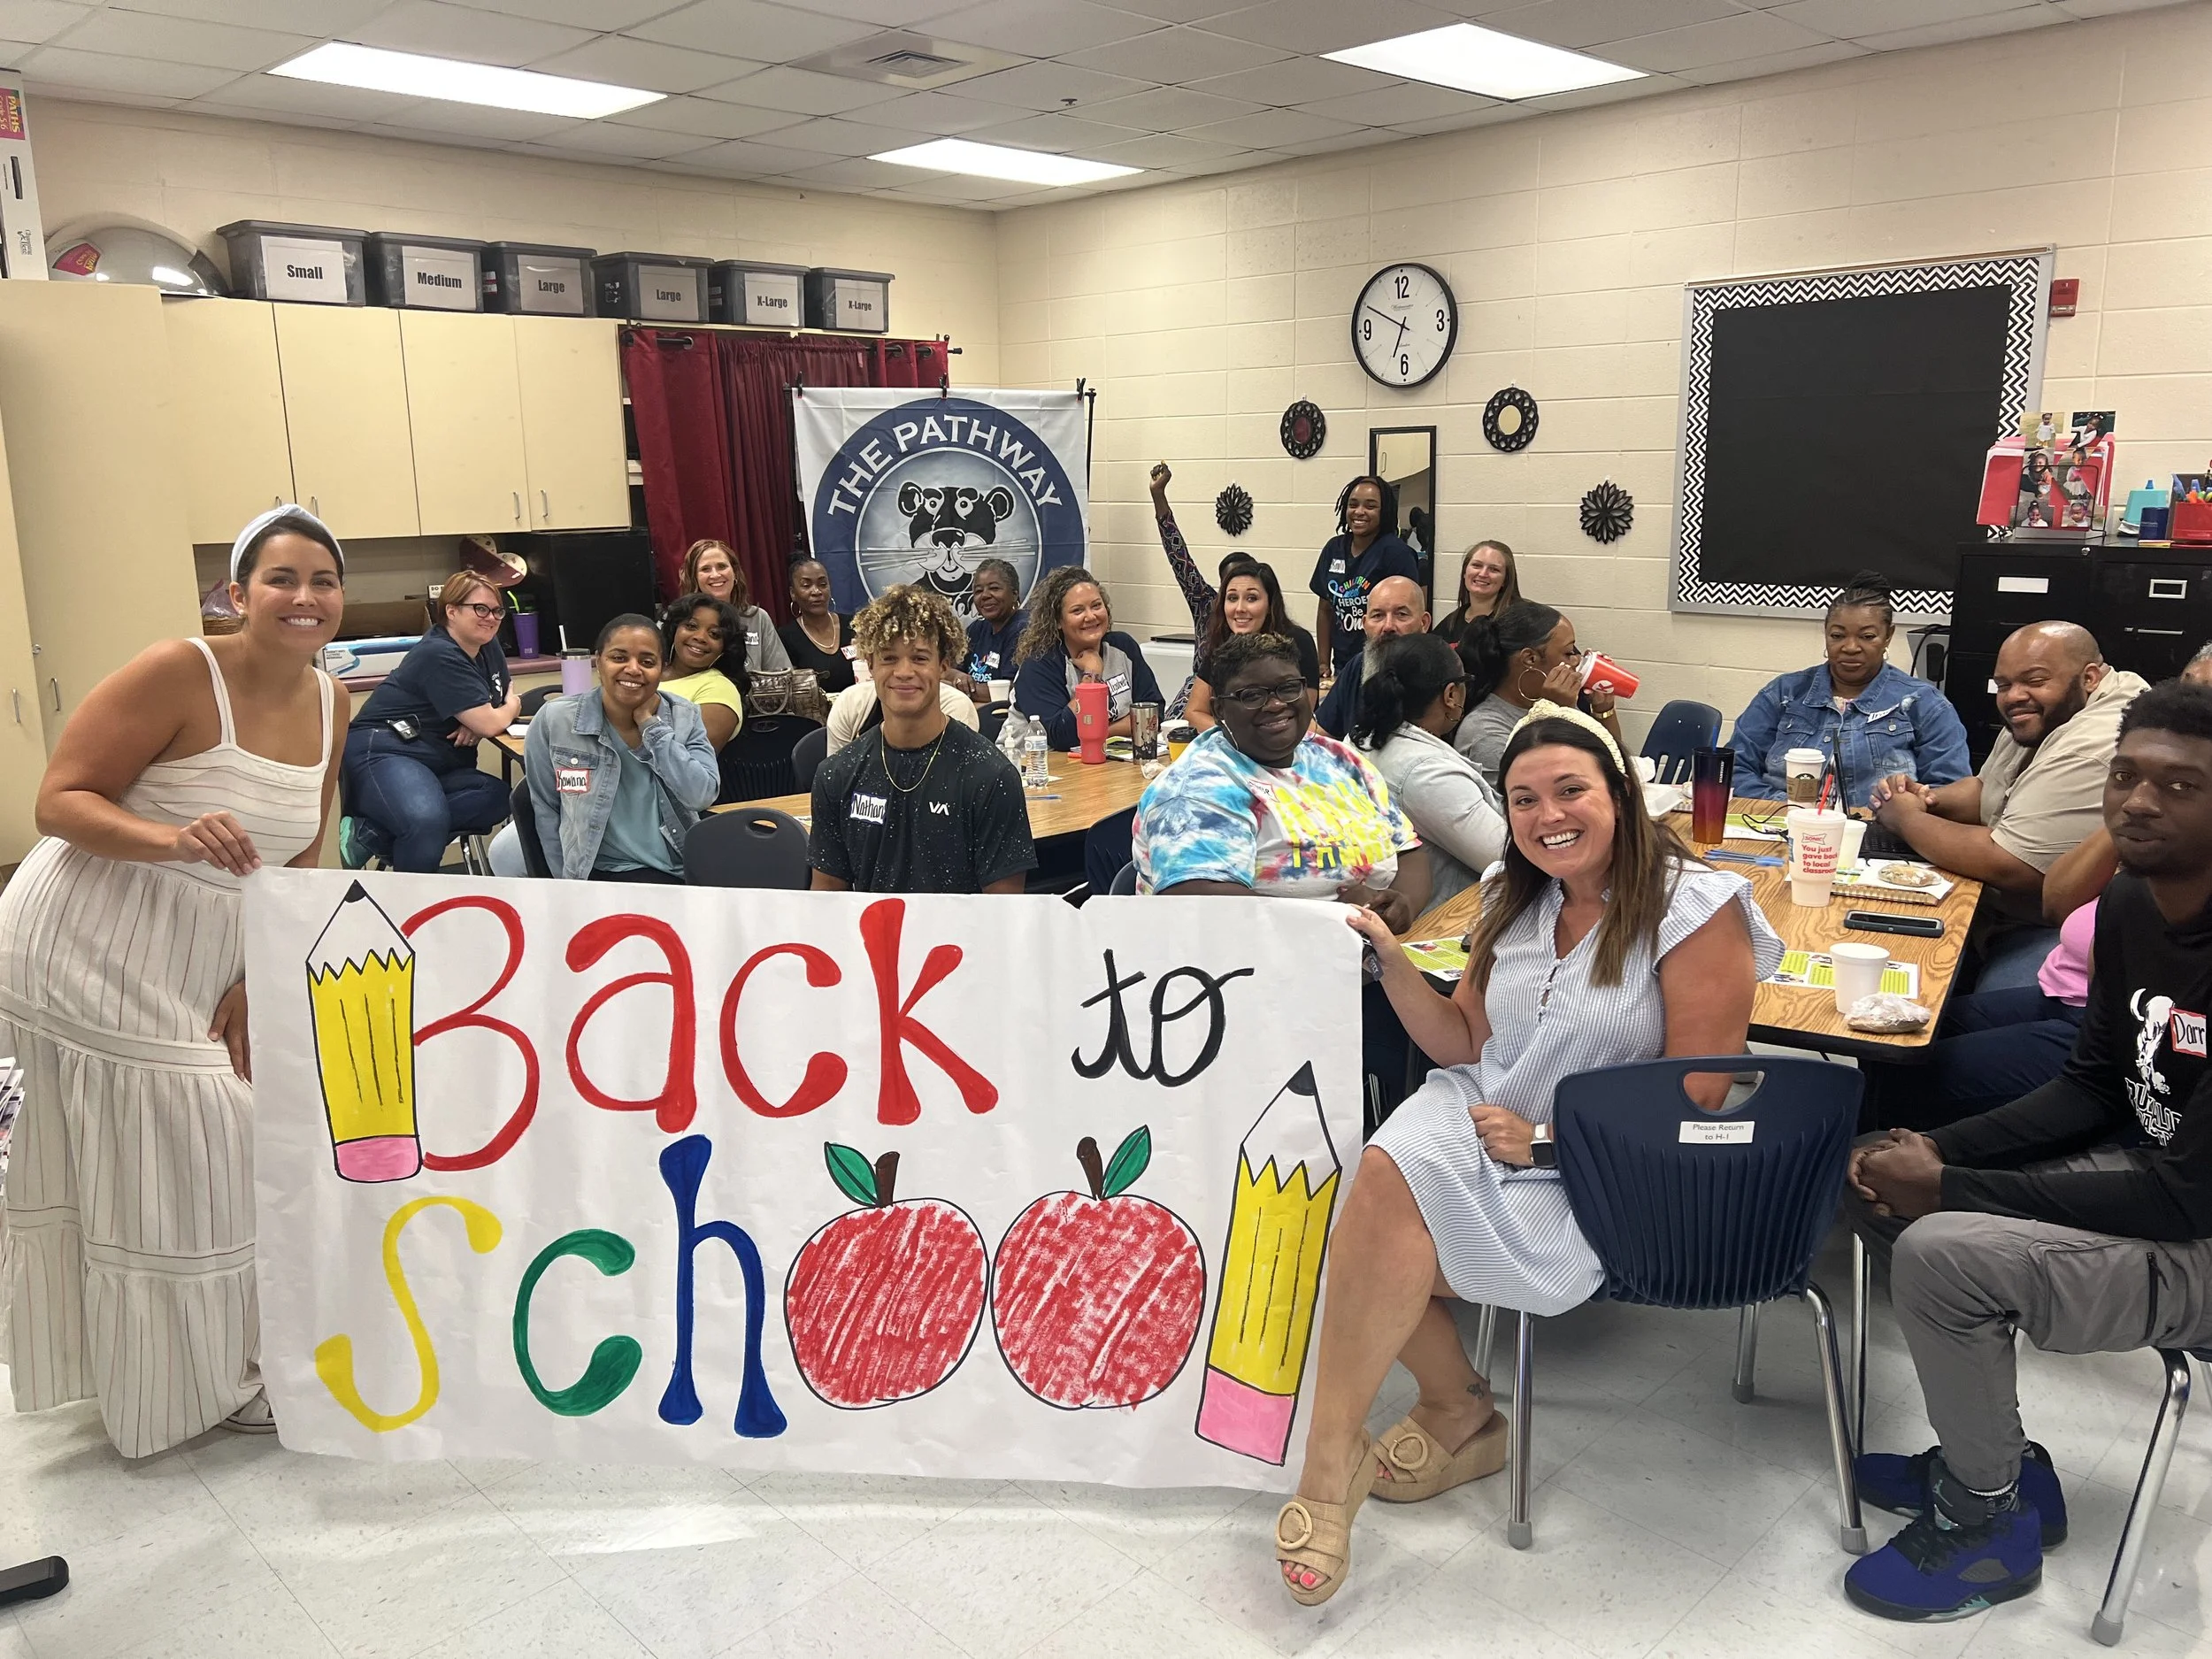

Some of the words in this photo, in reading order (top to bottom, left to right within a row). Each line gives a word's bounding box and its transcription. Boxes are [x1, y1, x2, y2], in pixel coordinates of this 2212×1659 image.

[8, 96, 20, 133] PATHS
[287, 265, 323, 280] Small
[418, 272, 463, 288] Medium
[538, 279, 565, 295] Large
[656, 288, 681, 303] Large
[1394, 275, 1409, 299] 12
[757, 295, 788, 309] X-Large
[848, 299, 872, 311] X-Large
[1436, 309, 1445, 332] 3
[1363, 319, 1371, 341] 9
[1400, 353, 1409, 376] 6
[827, 437, 894, 517] THE
[892, 413, 1064, 508] PATHWAY
[1338, 595, 1368, 607] HEROE
[1351, 605, 1364, 617] Be
[1343, 613, 1364, 632] On
[851, 794, 884, 819] Nathan
[1817, 845, 1832, 854] just
[305, 879, 999, 1182] Back
[1071, 949, 1255, 1088] to
